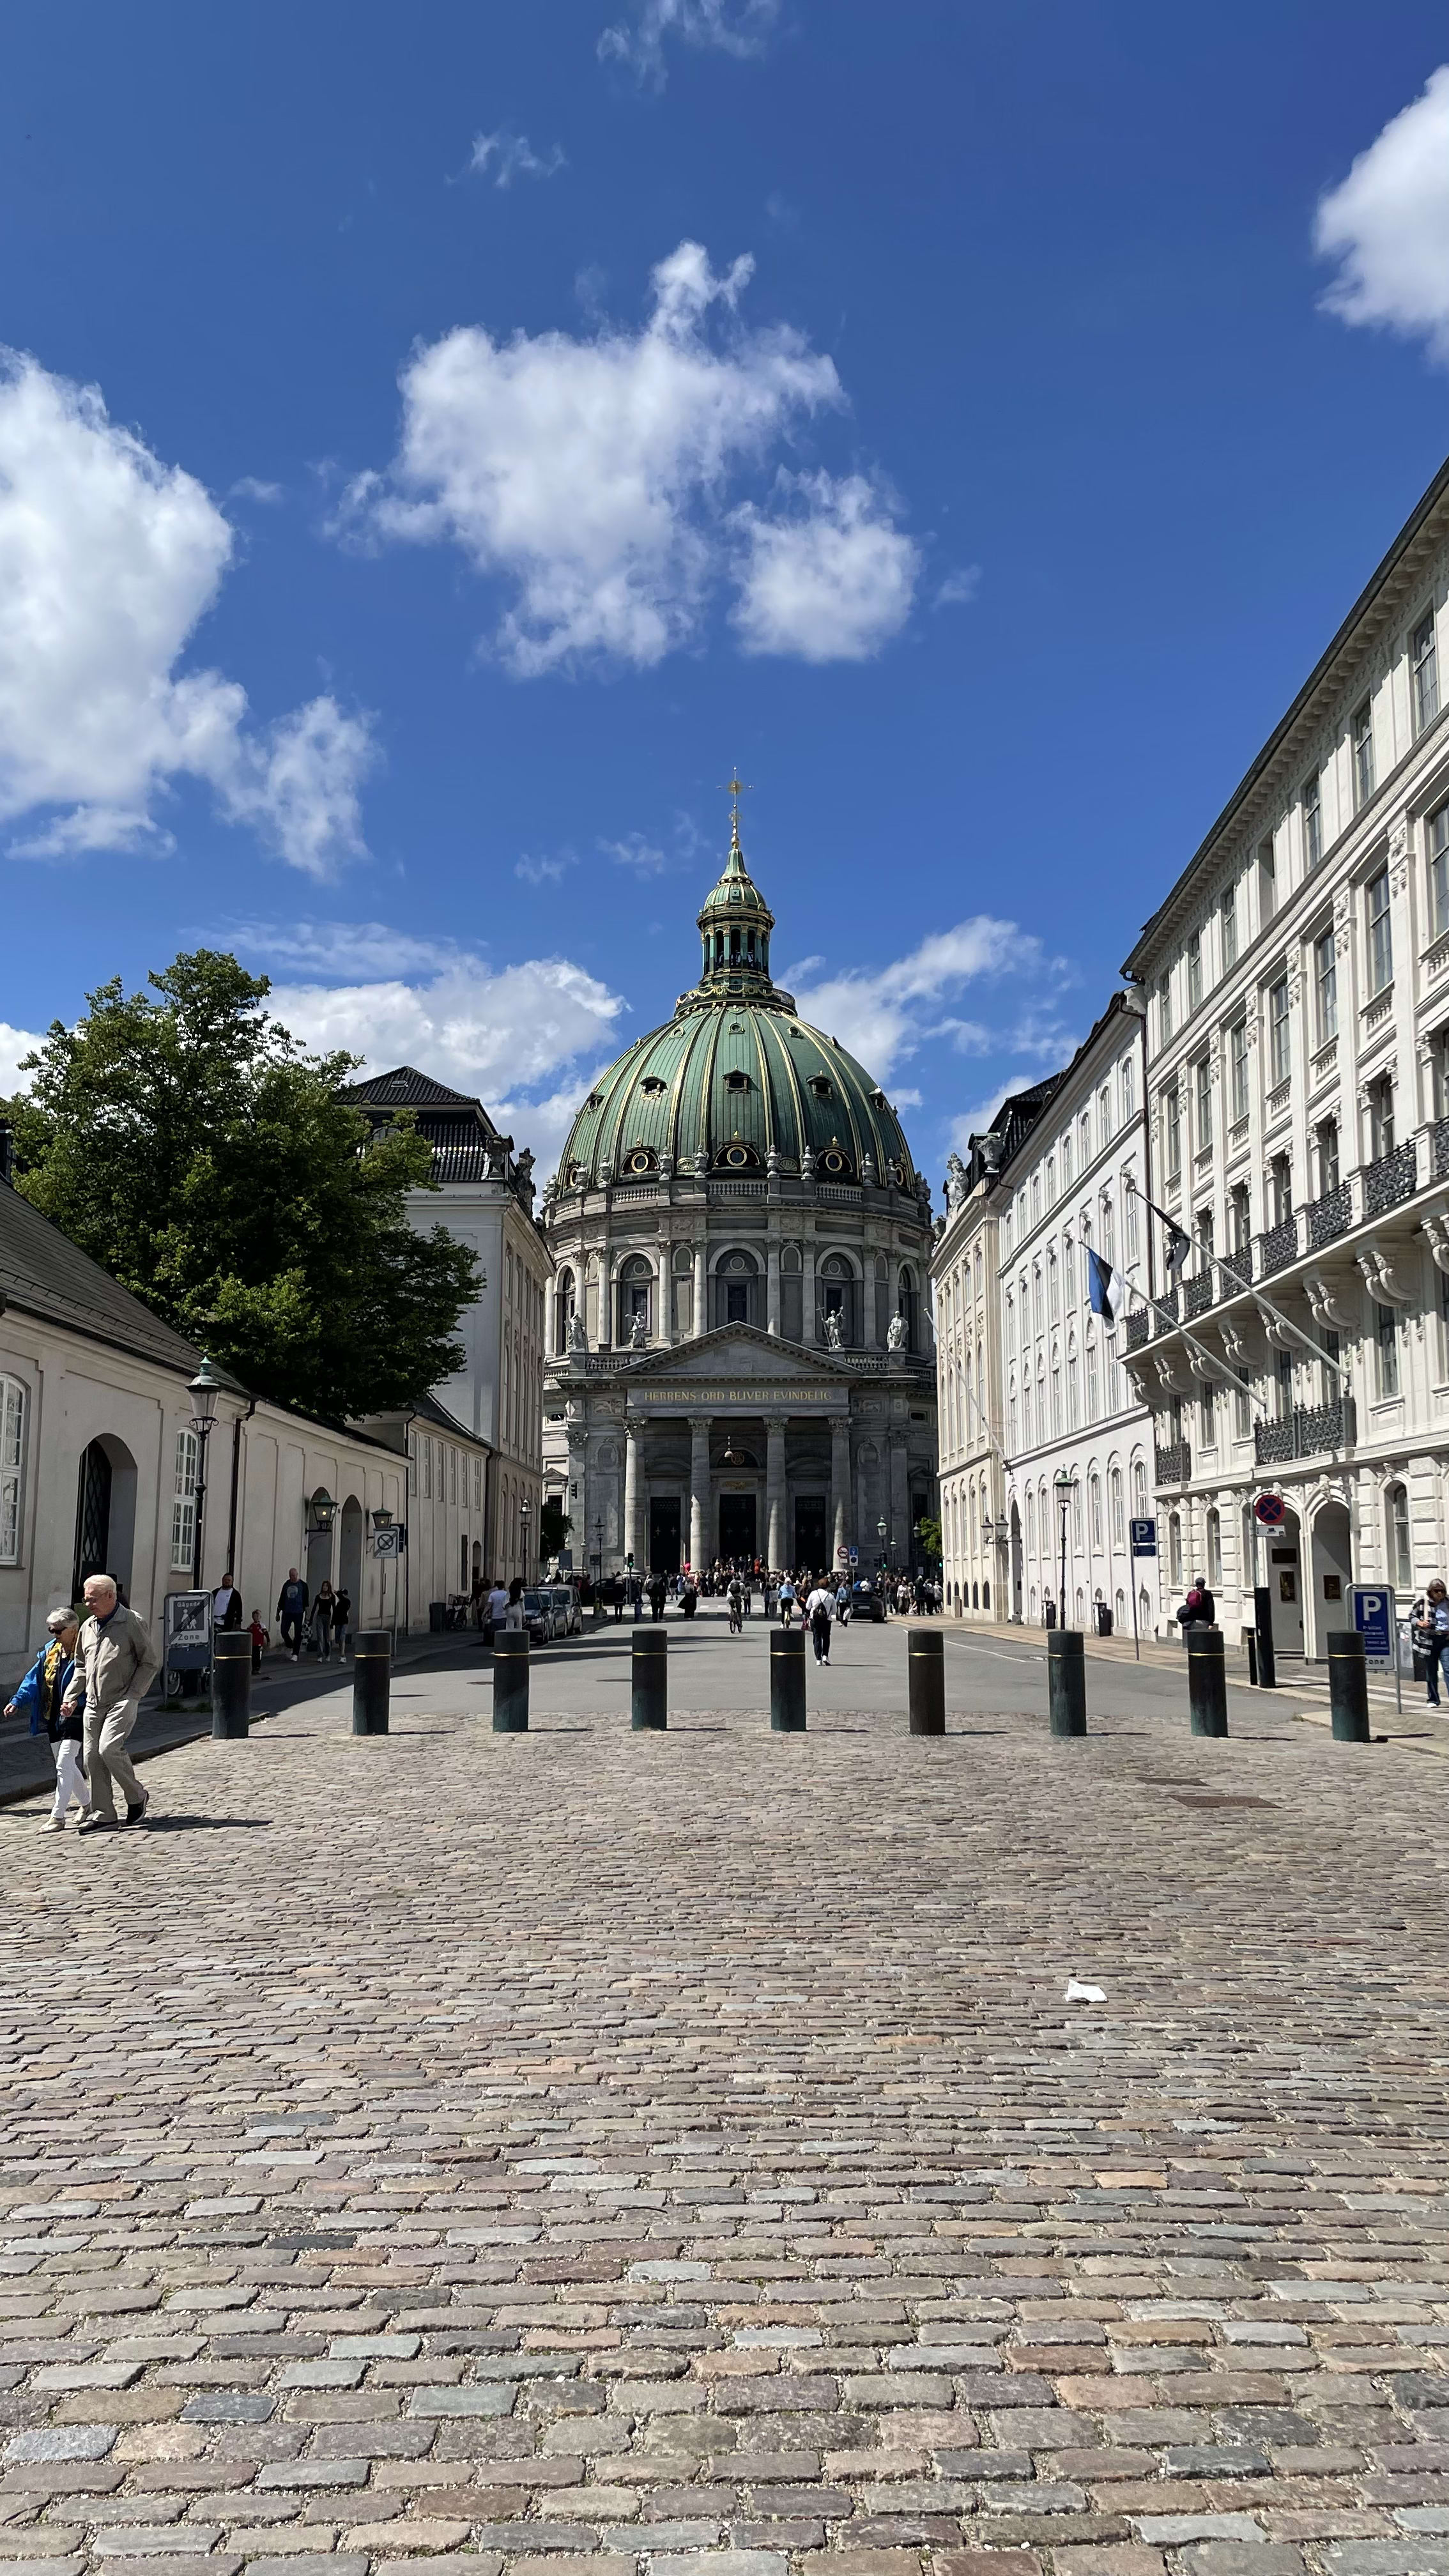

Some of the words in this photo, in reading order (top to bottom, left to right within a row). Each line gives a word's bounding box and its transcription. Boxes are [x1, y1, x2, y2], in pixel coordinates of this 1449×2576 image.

[645, 1391, 696, 1401] HERRENS
[701, 1391, 724, 1401] ORD
[730, 1391, 769, 1400] BLIVER
[774, 1391, 831, 1400] EVINDELIG
[1135, 1522, 1148, 1541] P
[1362, 1596, 1381, 1621] P
